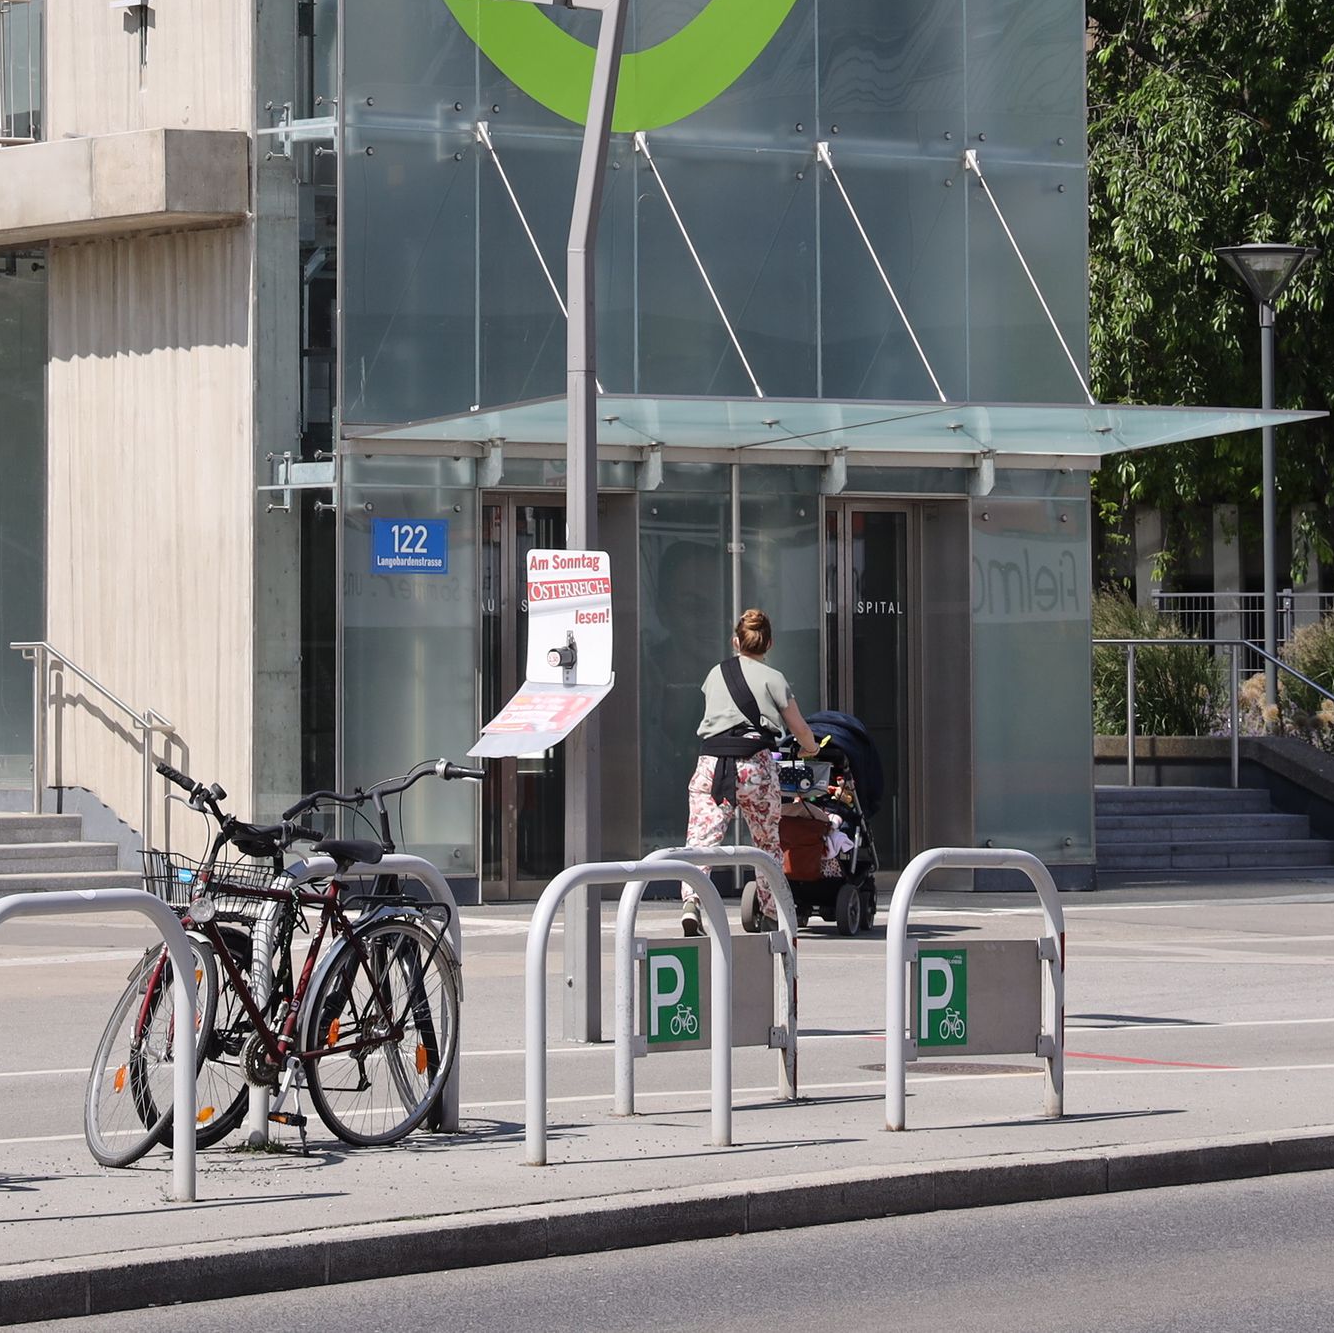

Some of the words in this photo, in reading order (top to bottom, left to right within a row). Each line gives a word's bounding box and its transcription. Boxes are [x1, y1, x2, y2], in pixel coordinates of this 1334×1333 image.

[391, 524, 428, 554] 122
[377, 554, 442, 569] Langobardenstrasse
[530, 555, 549, 570] Am
[552, 554, 600, 572] Sonntag
[857, 600, 904, 614] SPITAL
[575, 608, 610, 625] lesen!
[649, 955, 685, 1037] P
[920, 956, 954, 1040] P
